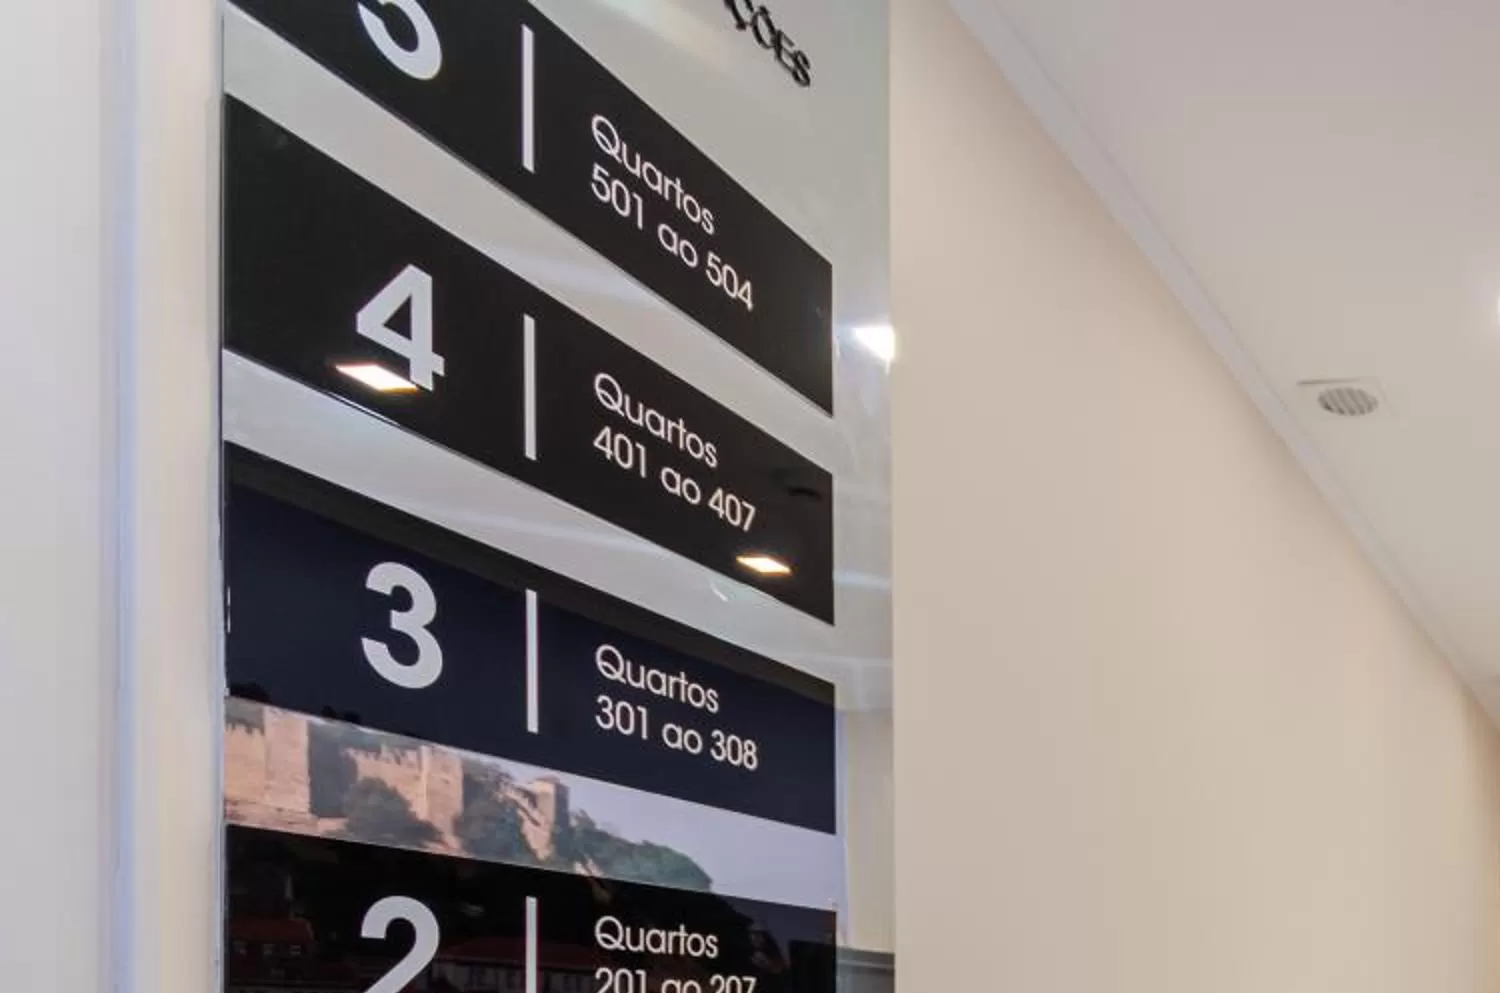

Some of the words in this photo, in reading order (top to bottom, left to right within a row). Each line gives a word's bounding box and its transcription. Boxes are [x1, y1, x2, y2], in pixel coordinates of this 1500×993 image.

[591, 114, 715, 236] Quartos
[590, 164, 646, 229] 501
[658, 223, 698, 269] ao
[705, 256, 755, 312] 504
[356, 264, 445, 391] 4
[594, 373, 718, 469] Quartos
[593, 426, 648, 479] 401
[661, 466, 701, 504] ao
[708, 488, 757, 533] 407
[361, 561, 443, 689] 3
[595, 645, 719, 713] Quartos
[595, 696, 649, 741] 301
[662, 721, 702, 754] ao
[710, 728, 759, 772] 308
[595, 915, 719, 958] Quartos
